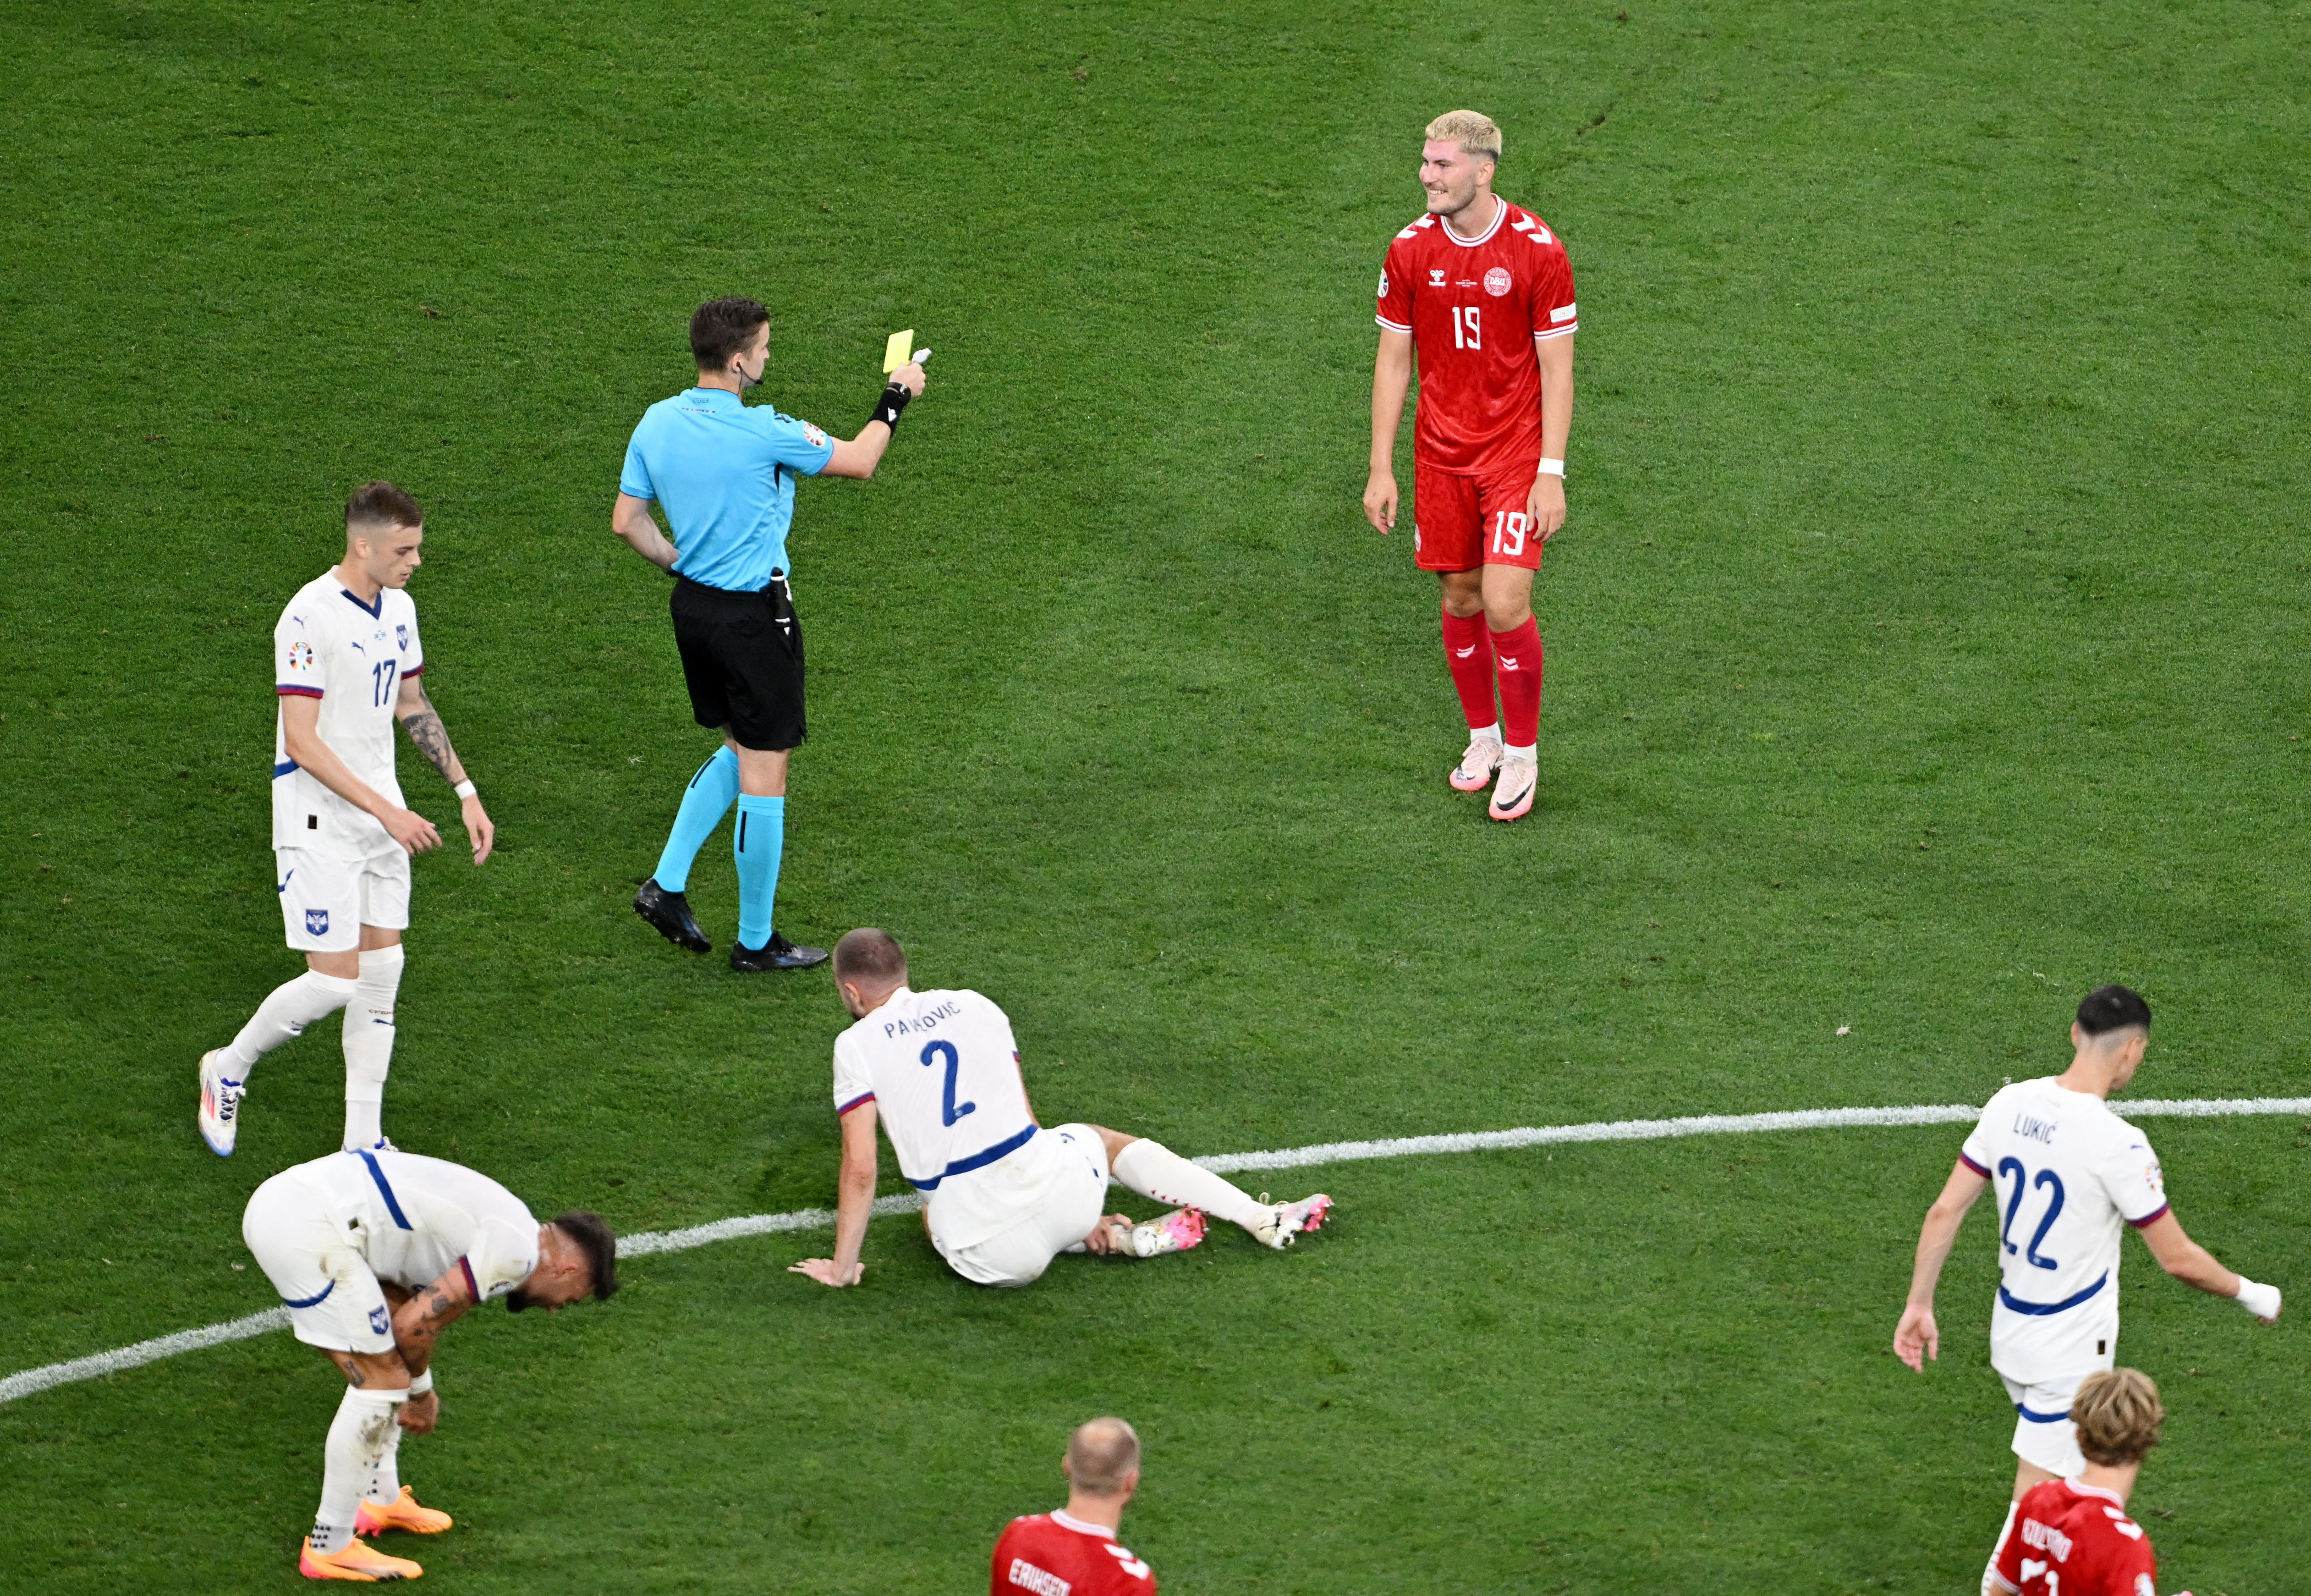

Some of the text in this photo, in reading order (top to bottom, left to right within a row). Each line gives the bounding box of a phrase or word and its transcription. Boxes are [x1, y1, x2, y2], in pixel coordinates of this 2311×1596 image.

[1489, 277, 1505, 286] DBU
[1452, 306, 1481, 350] 19
[1492, 510, 1527, 555] 19
[373, 659, 396, 707] 17
[920, 1039, 976, 1127] 2
[2013, 1111, 2058, 1144] LUKIĆ
[1999, 1156, 2065, 1271] 22
